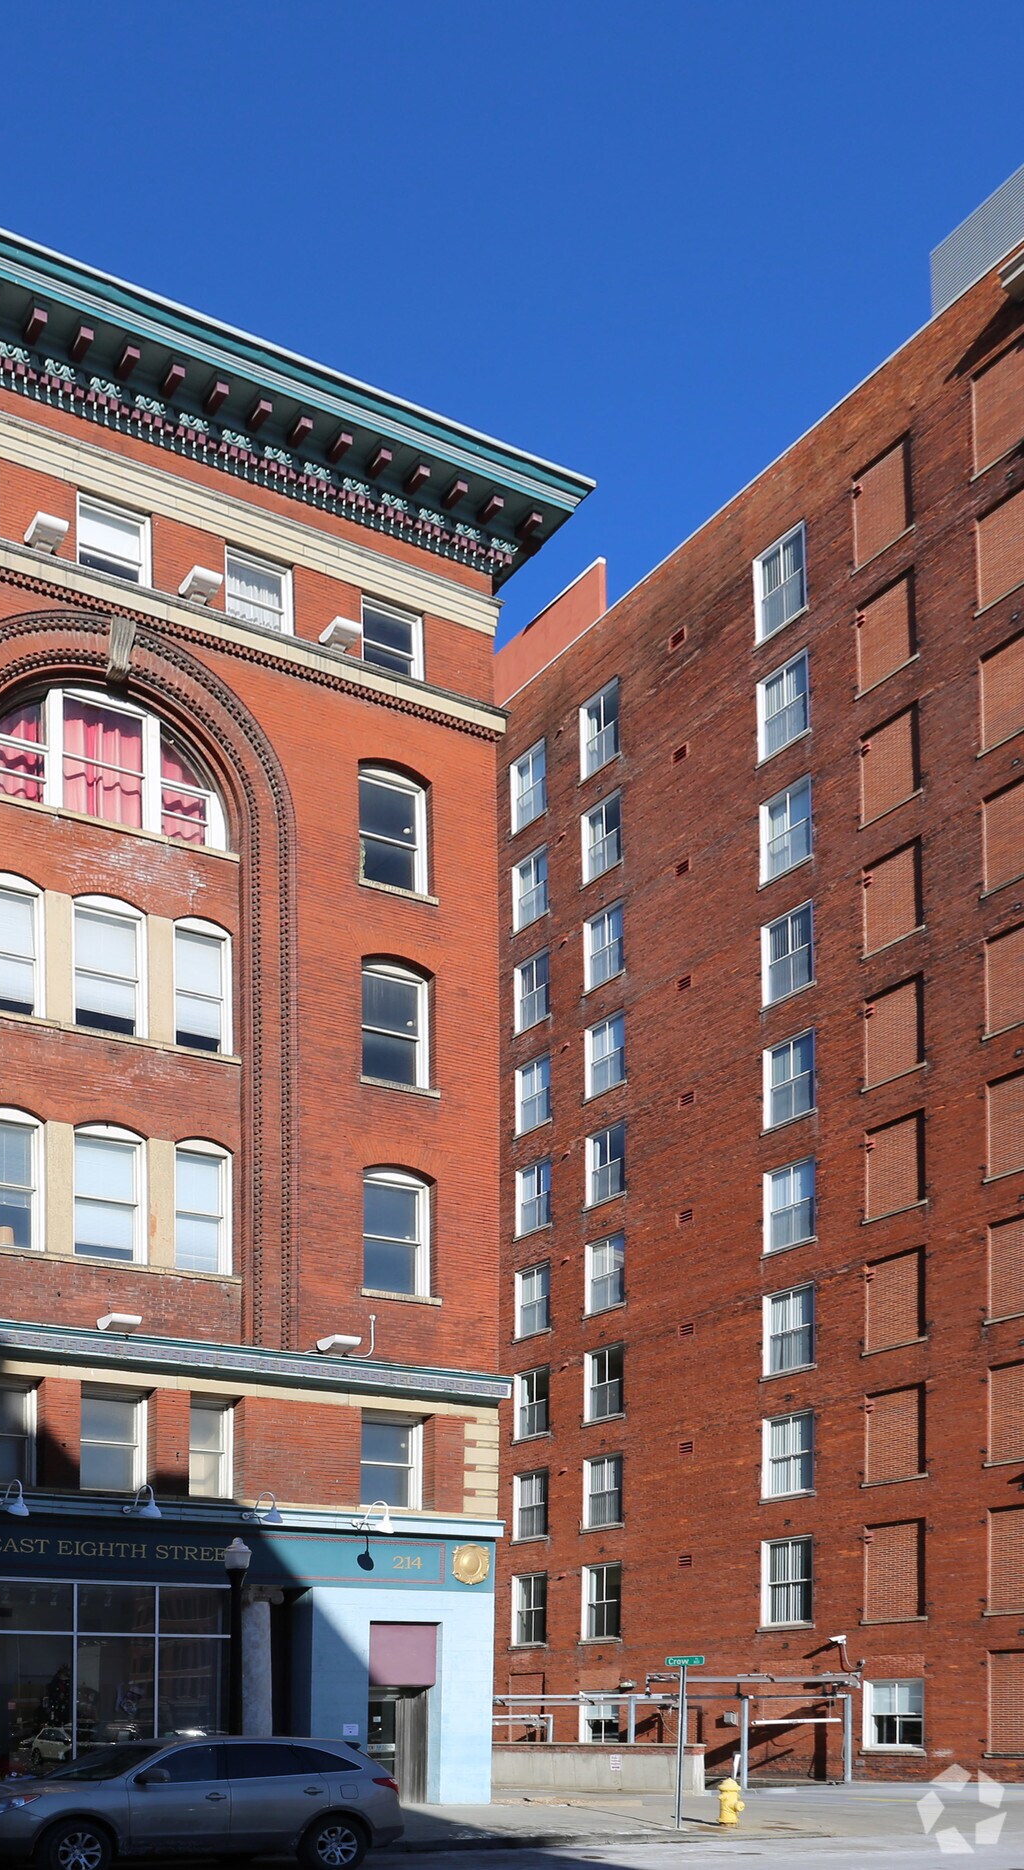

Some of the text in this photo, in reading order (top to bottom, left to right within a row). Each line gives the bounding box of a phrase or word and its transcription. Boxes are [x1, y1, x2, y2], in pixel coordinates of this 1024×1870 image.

[57, 1540, 147, 1559] EIGHTH
[155, 1544, 227, 1562] STREE
[392, 1555, 423, 1570] 214
